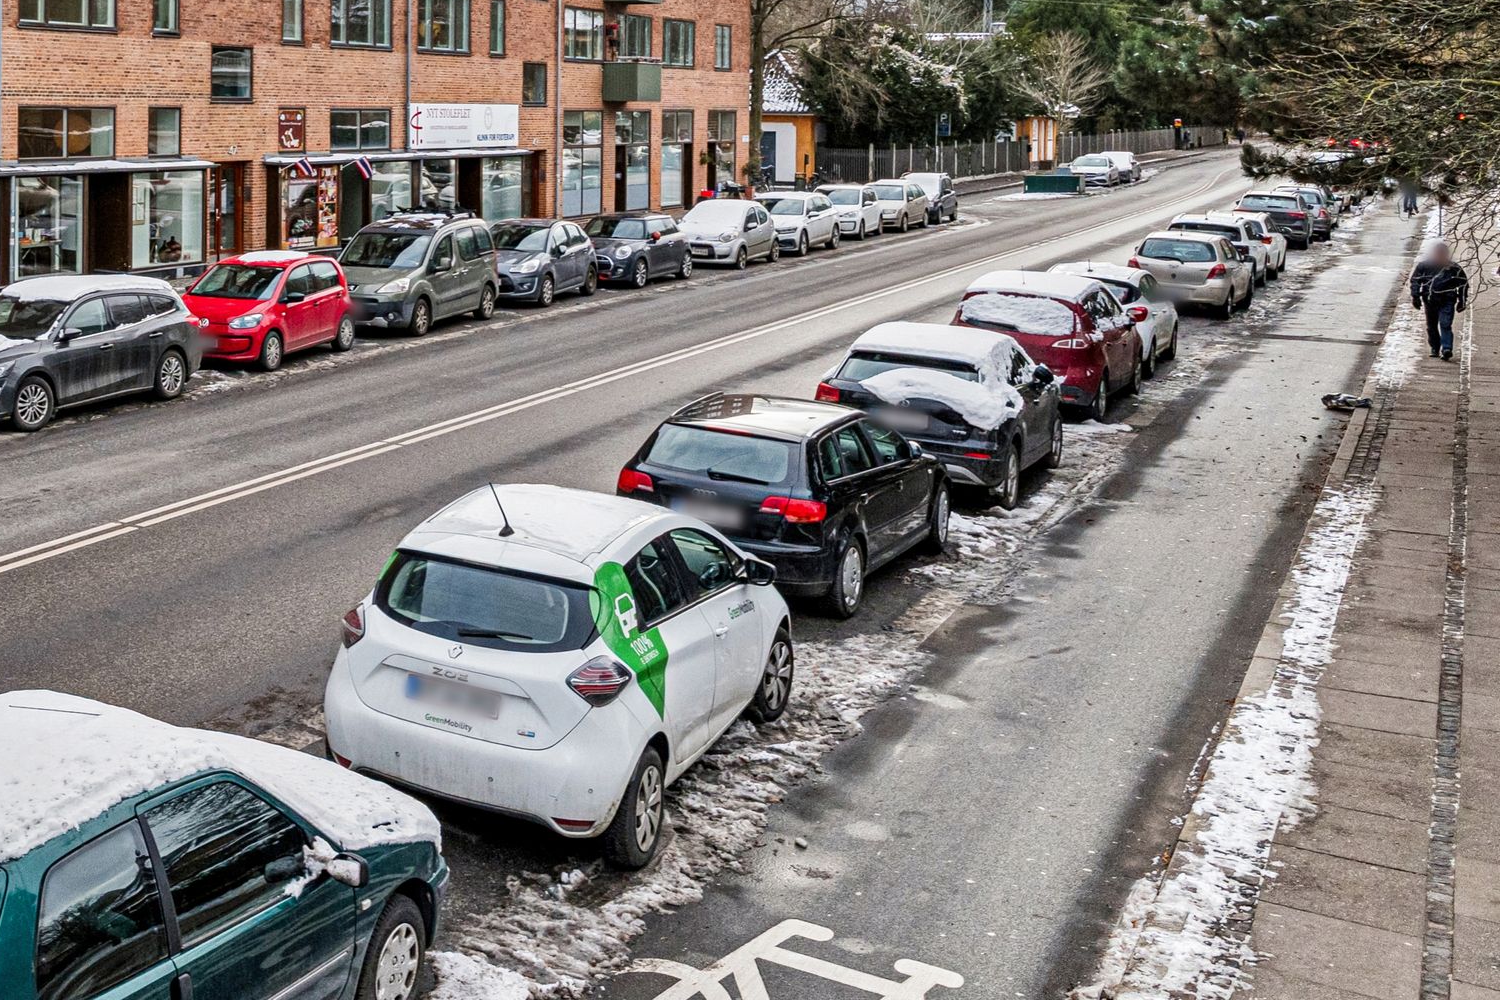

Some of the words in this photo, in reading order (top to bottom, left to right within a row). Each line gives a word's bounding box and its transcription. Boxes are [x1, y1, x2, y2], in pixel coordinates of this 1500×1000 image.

[940, 113, 948, 123] P
[630, 634, 655, 657] 100%
[425, 713, 473, 733] GreenMobility
